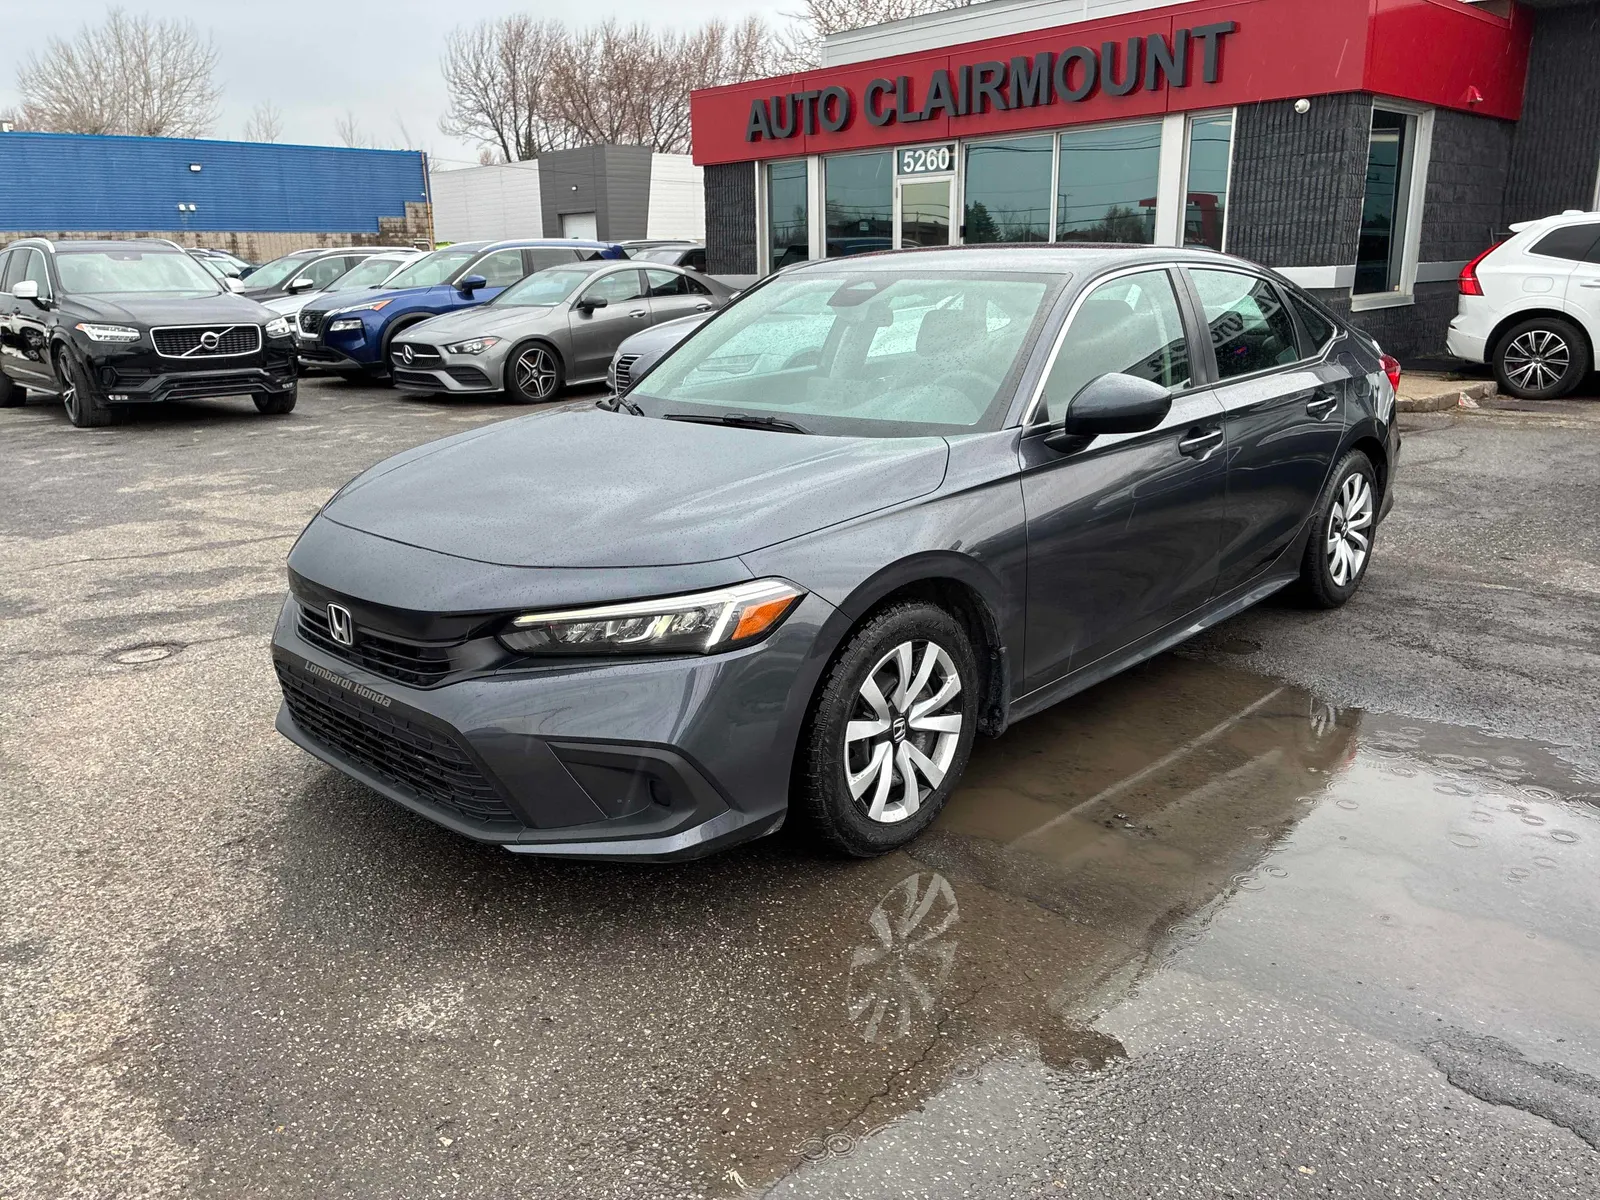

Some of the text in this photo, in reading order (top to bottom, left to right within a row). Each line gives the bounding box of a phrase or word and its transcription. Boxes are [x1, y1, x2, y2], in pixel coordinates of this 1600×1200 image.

[745, 21, 1236, 142] AUTO CLAIRMOUNT
[903, 147, 950, 173] 5260
[304, 660, 392, 708] Lombardi Honda
